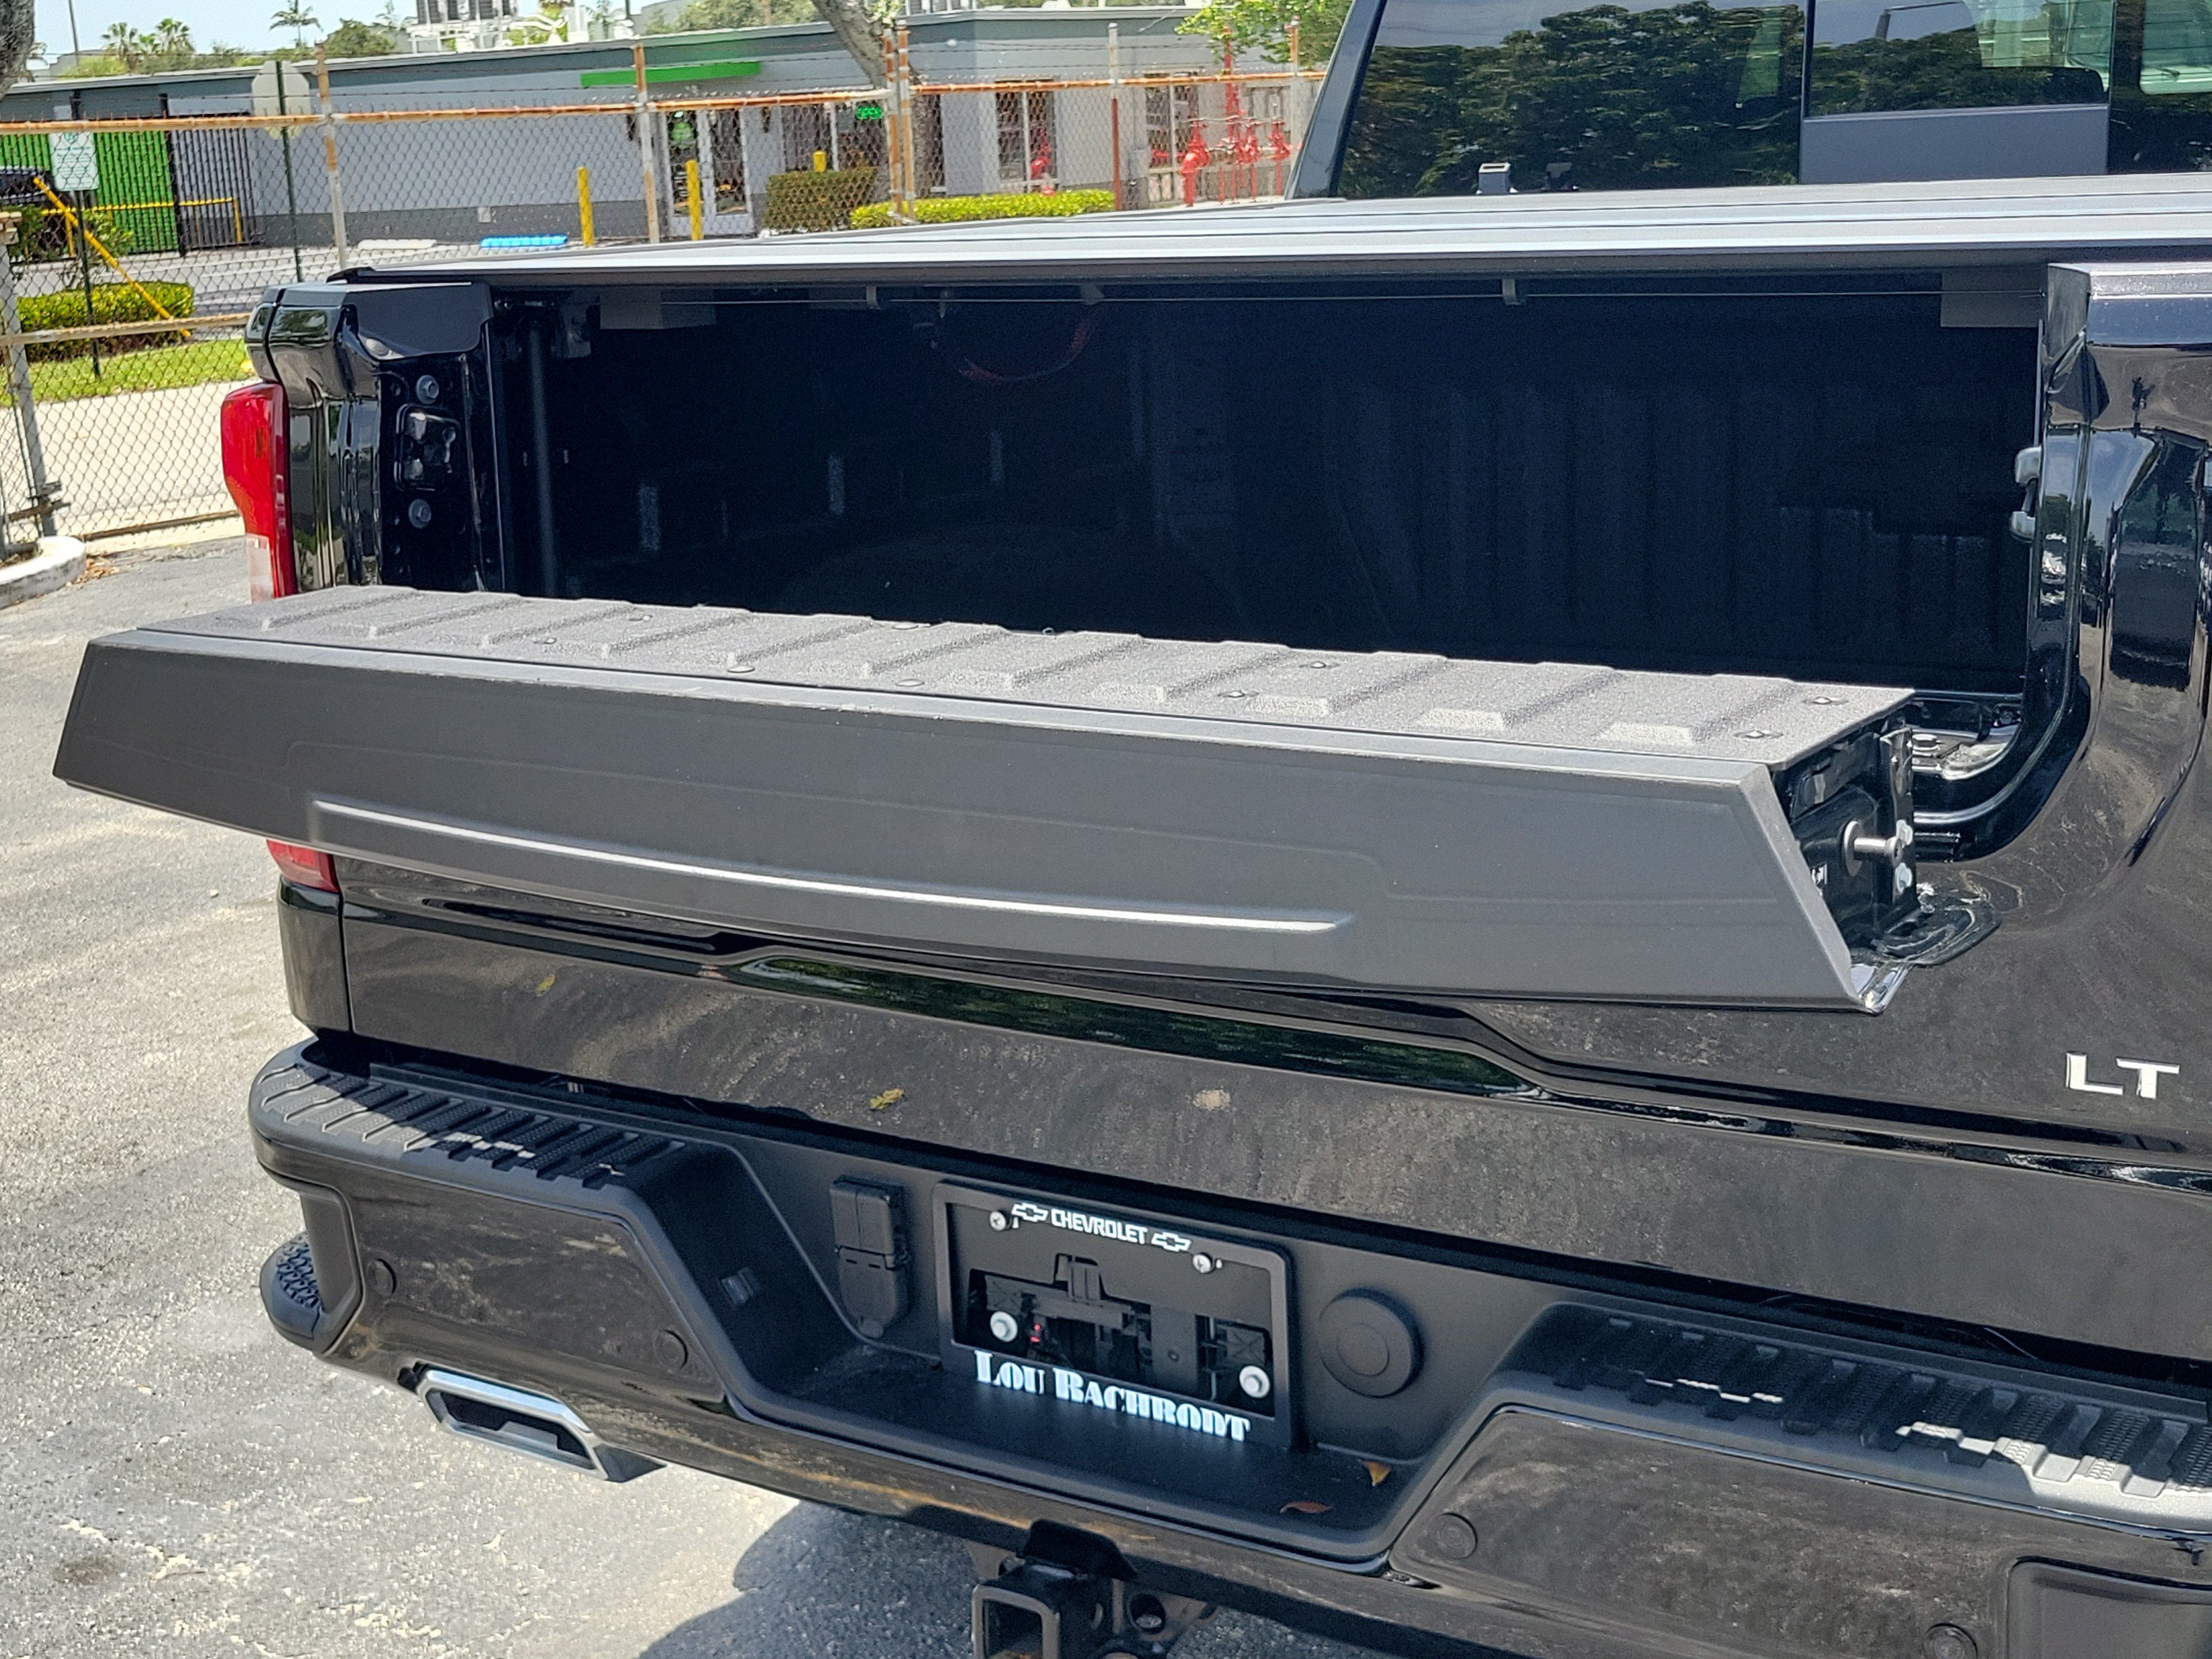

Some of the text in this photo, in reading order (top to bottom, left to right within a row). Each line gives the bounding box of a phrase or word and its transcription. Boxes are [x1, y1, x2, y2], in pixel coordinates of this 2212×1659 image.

[2065, 1052, 2180, 1099] LT
[1051, 1208, 1148, 1245] CHEVROLET
[974, 1350, 1046, 1395] LOU
